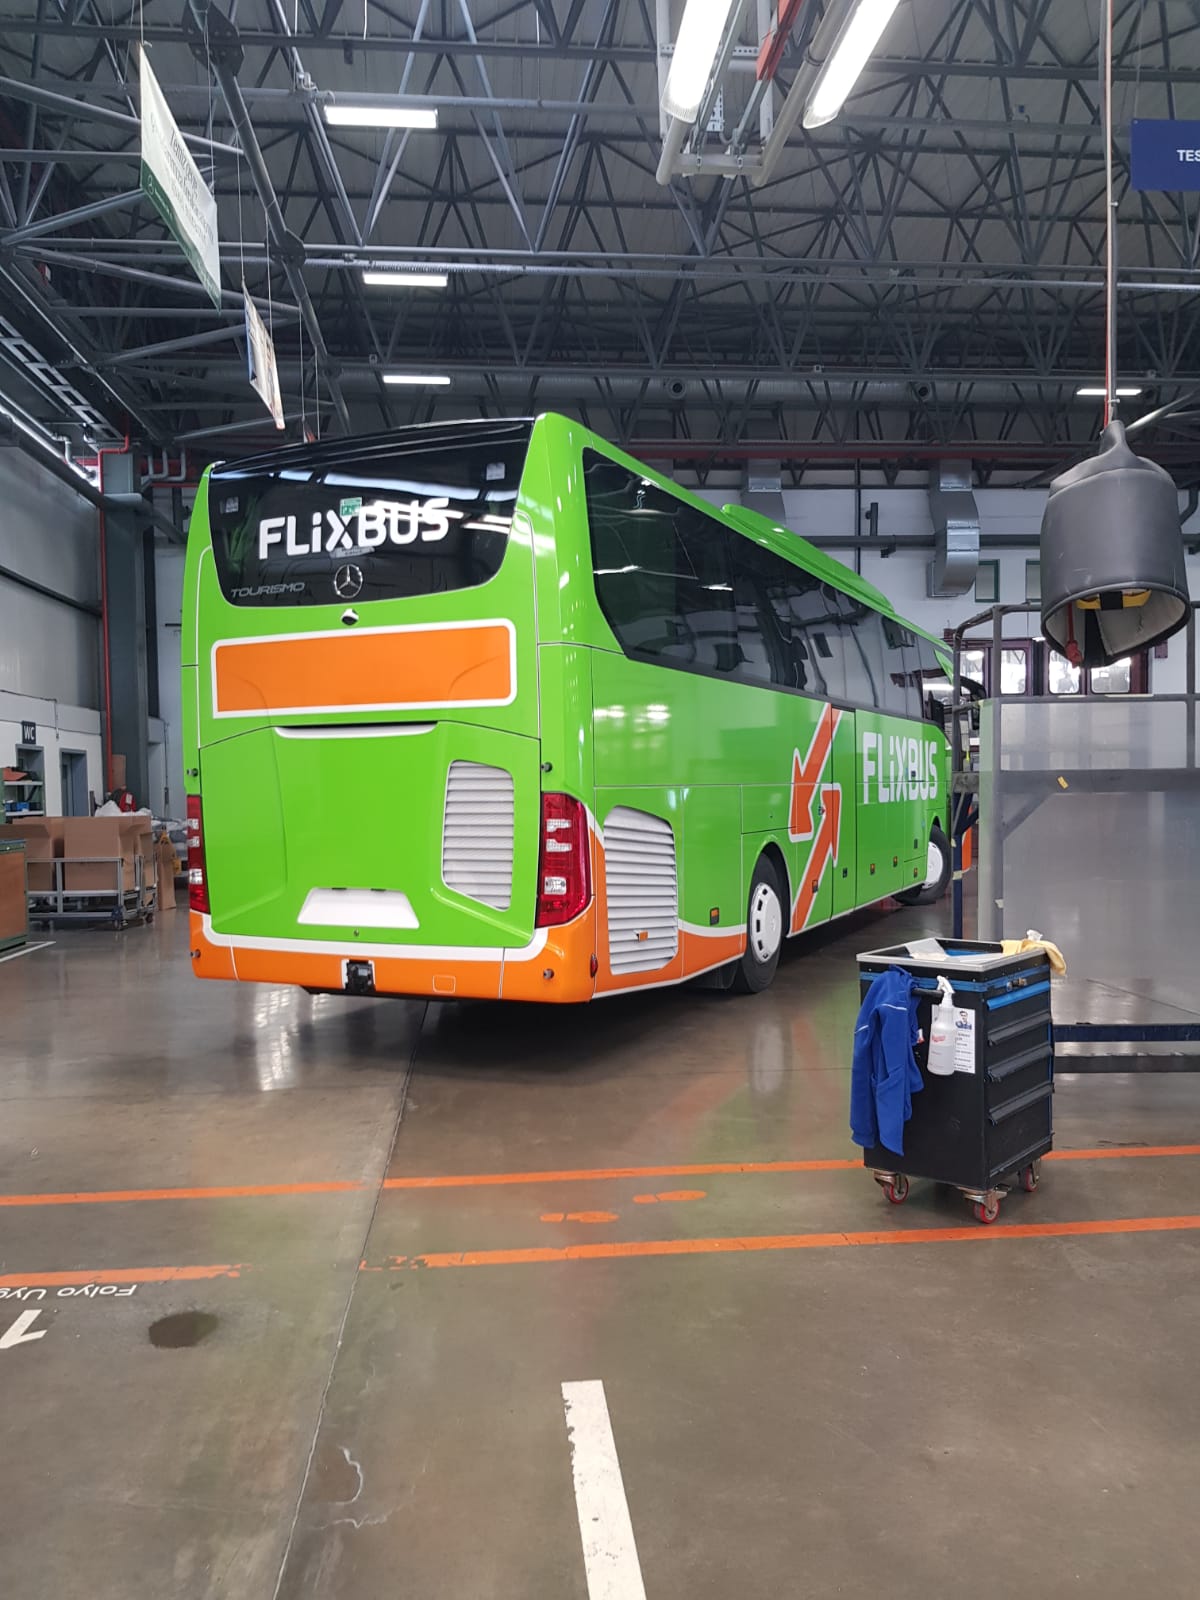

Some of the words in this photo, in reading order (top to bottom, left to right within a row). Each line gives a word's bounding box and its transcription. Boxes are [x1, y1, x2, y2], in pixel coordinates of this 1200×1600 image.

[230, 582, 305, 599] TOURISMO
[23, 725, 35, 740] WC
[57, 1284, 137, 1298] Folyo
